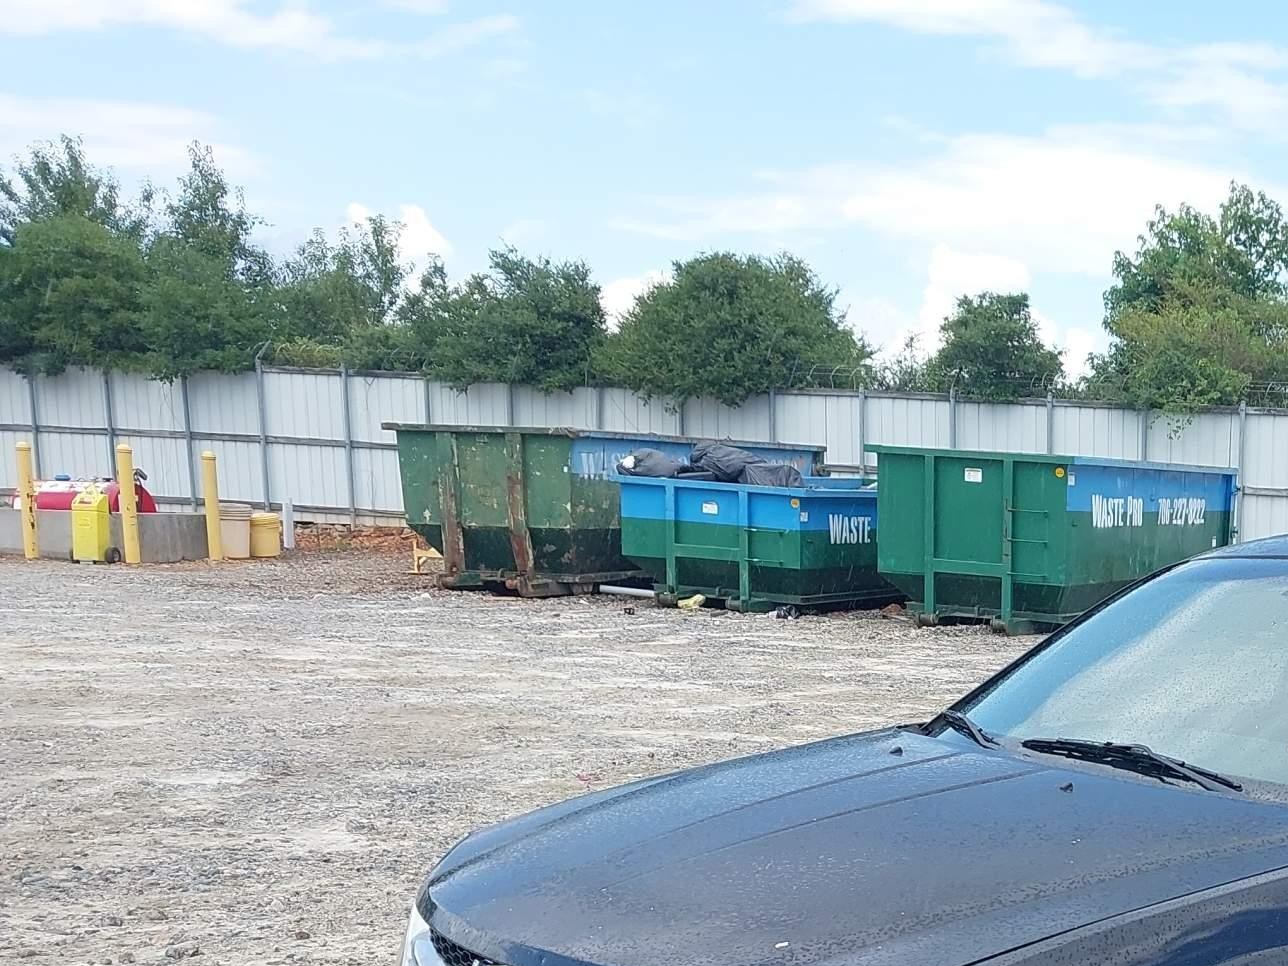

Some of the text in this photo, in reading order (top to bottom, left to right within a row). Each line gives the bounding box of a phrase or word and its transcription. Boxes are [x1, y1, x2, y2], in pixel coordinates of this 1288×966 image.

[1091, 494, 1125, 528] WASTE
[1126, 495, 1143, 527] PRO
[828, 513, 872, 545] WASTE
